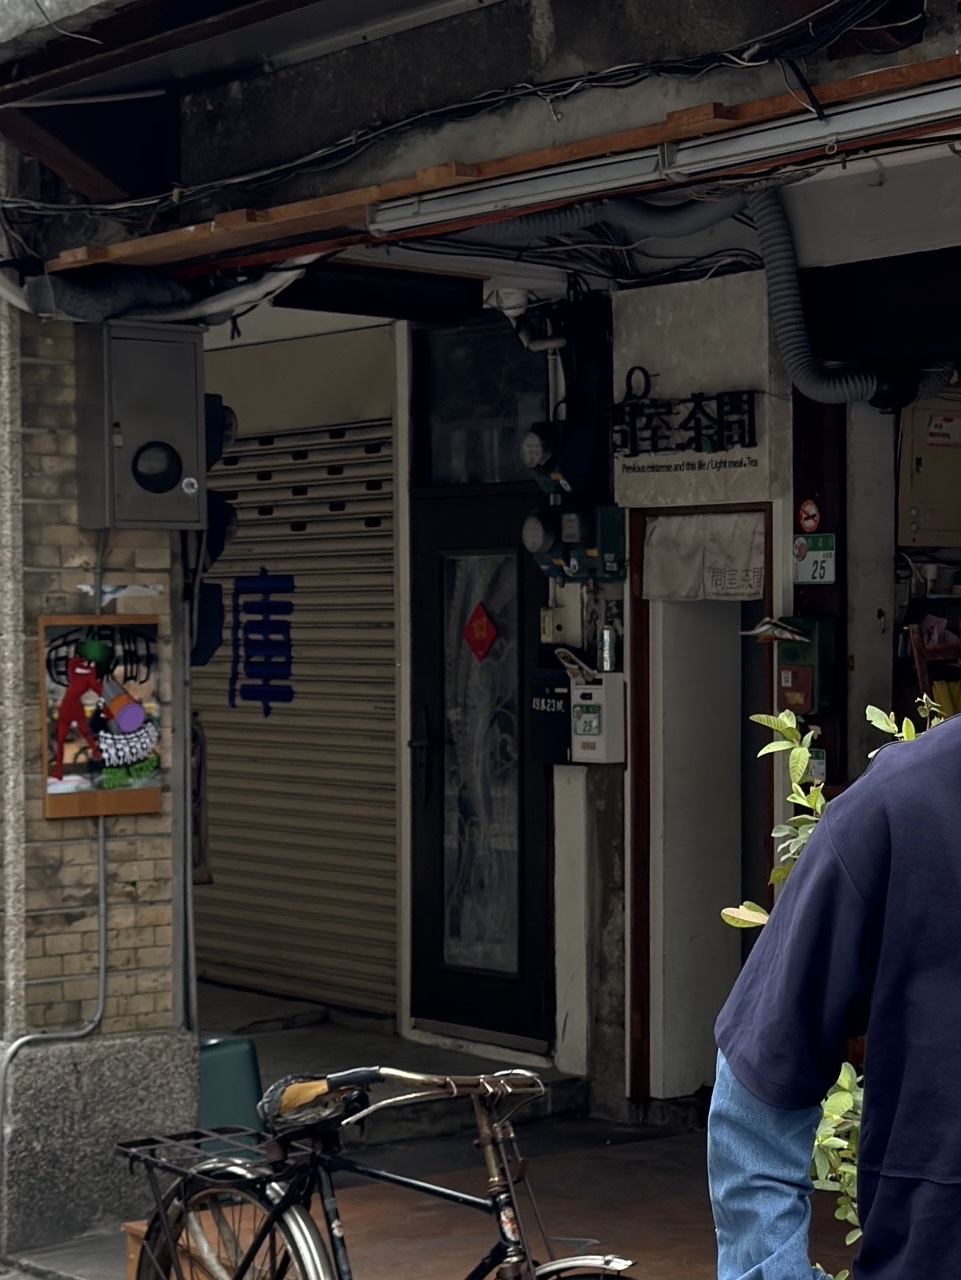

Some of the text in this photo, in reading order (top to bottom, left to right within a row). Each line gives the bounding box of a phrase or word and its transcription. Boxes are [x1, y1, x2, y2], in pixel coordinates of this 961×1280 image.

[673, 461, 684, 472] and
[711, 458, 727, 472] Light
[727, 458, 743, 469] meal
[747, 456, 758, 468] Tea
[811, 560, 826, 580] 25
